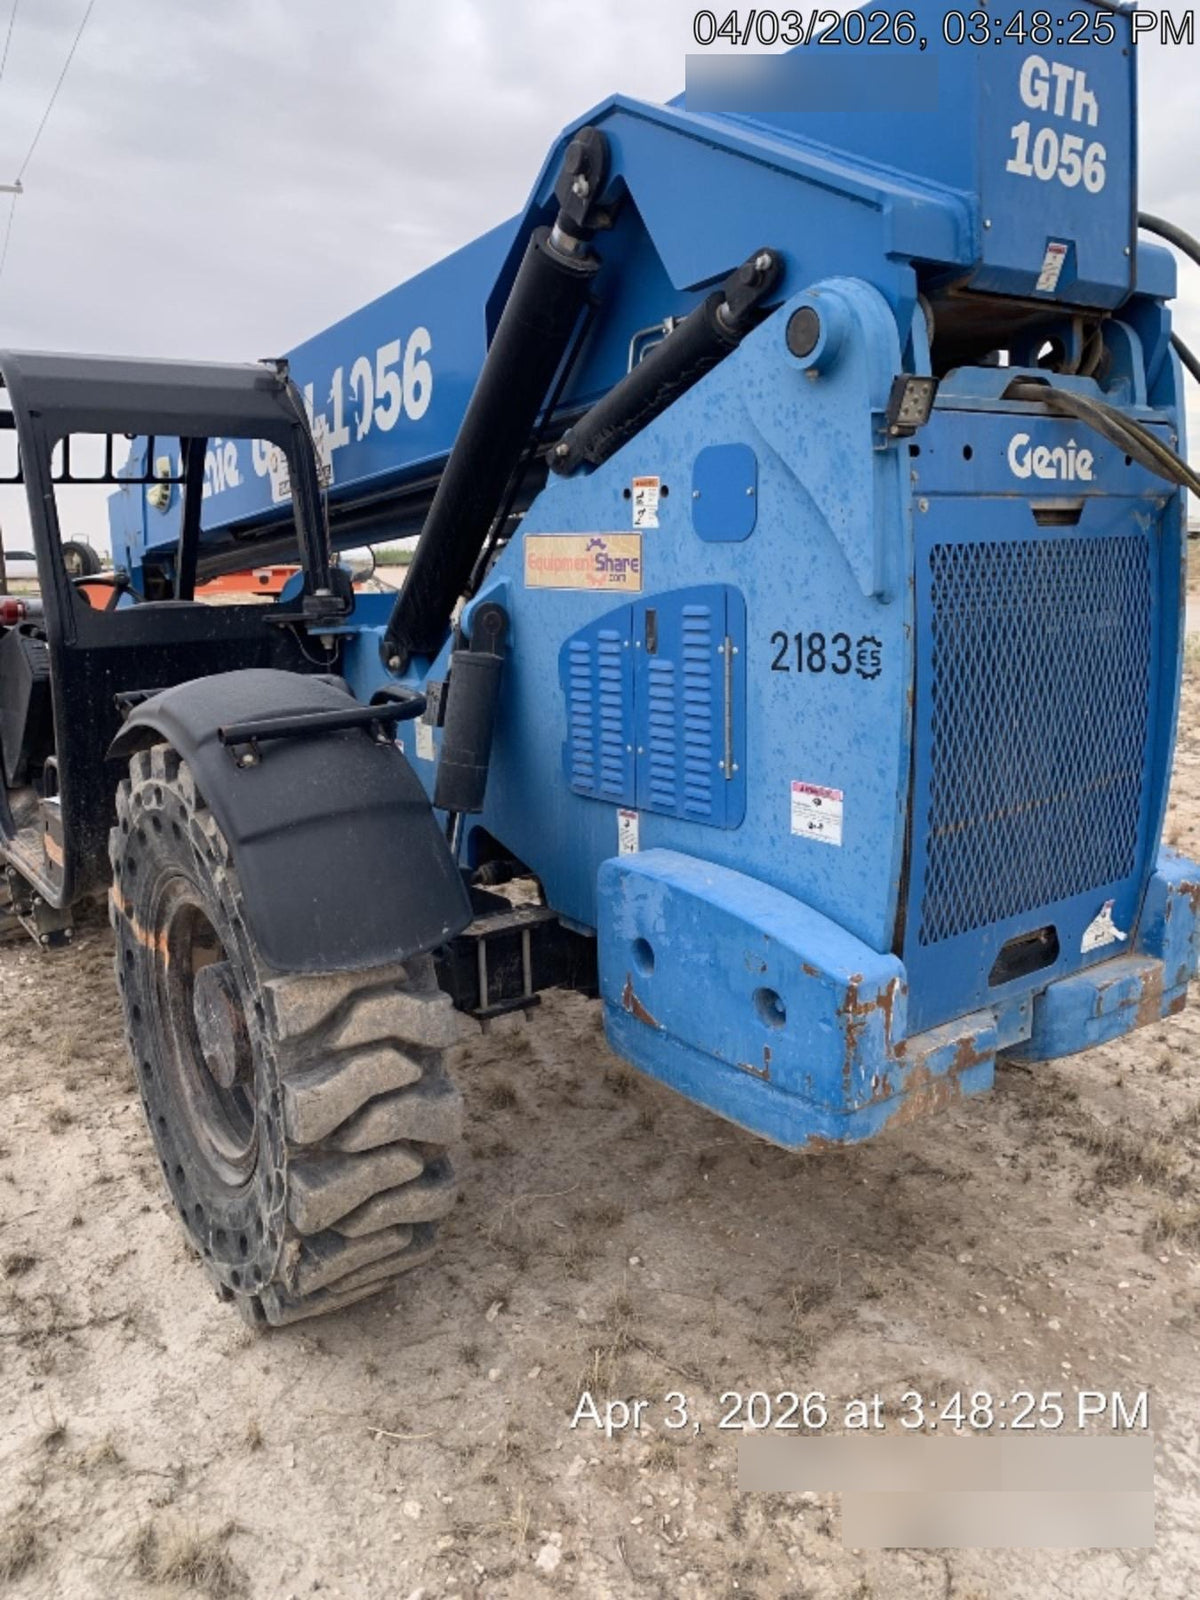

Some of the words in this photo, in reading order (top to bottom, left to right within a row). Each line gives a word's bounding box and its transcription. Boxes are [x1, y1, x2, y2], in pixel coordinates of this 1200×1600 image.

[1020, 54, 1099, 127] GTh
[1006, 120, 1107, 193] 1056
[1007, 432, 1094, 481] Genie
[770, 630, 852, 675] 2183
